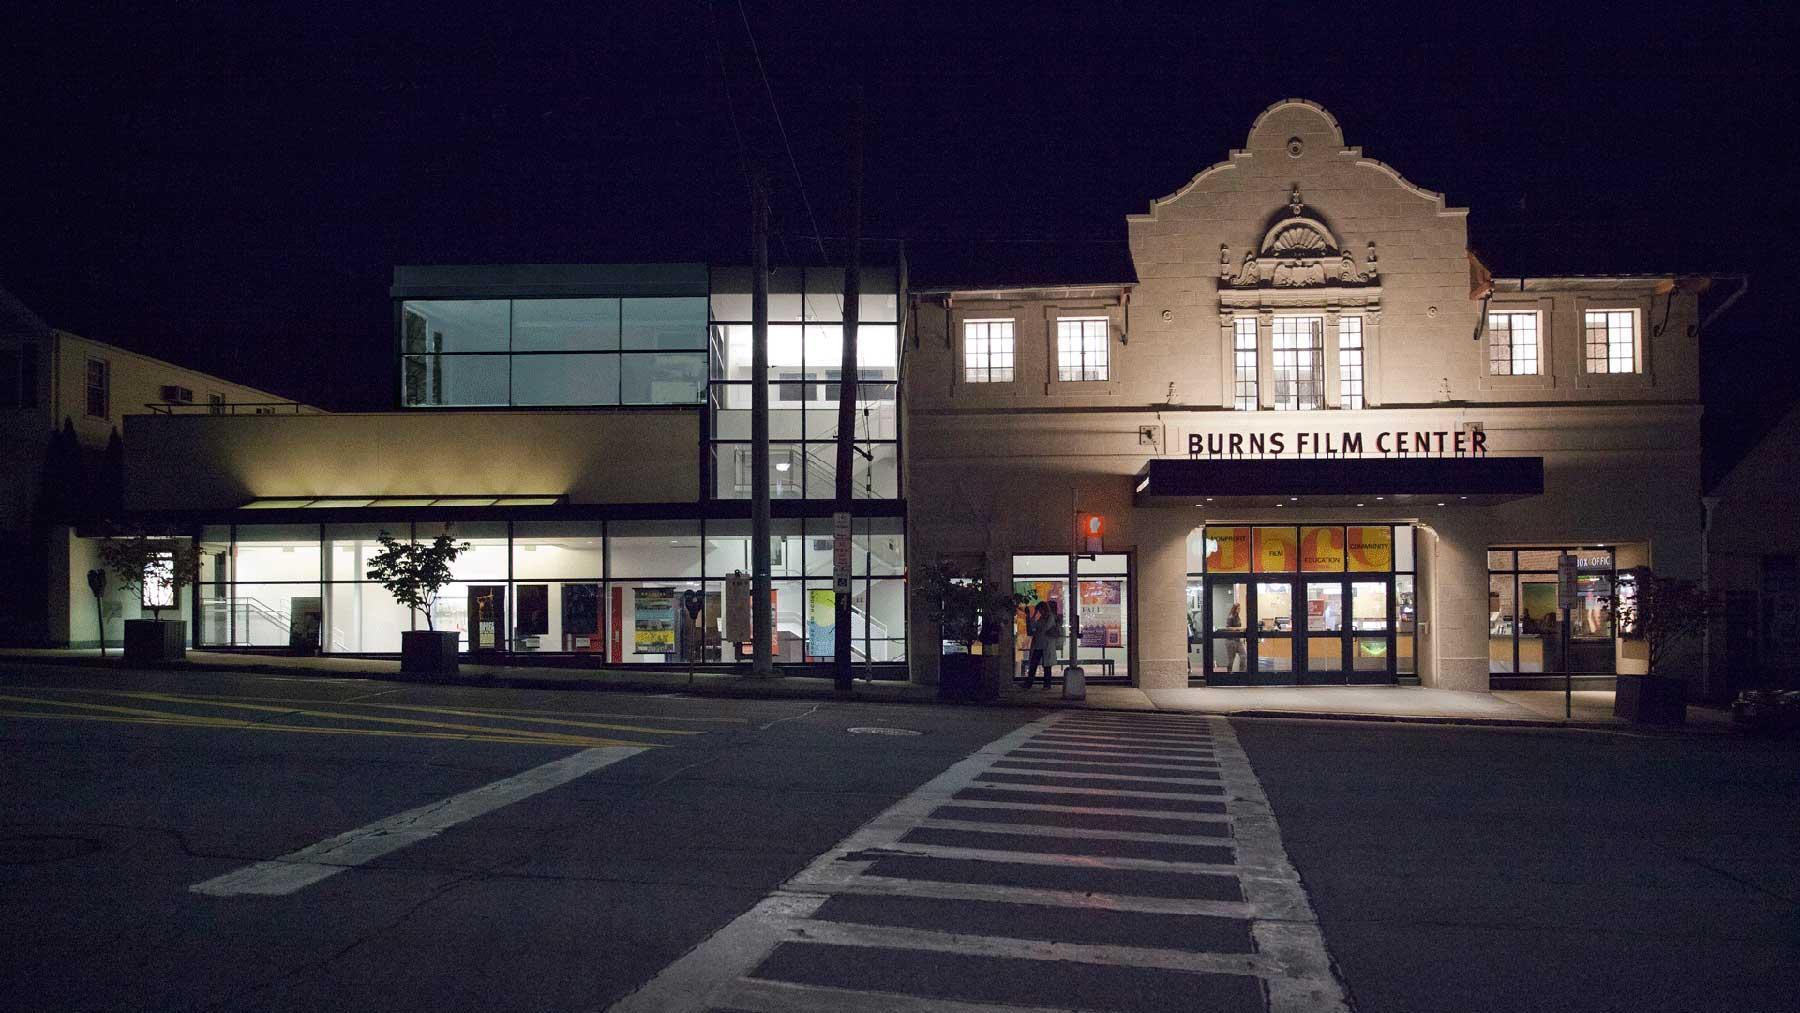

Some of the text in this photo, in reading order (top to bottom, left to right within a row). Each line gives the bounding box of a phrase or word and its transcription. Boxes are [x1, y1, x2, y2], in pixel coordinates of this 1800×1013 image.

[1188, 431, 1487, 454] BURNS FILM CENTER
